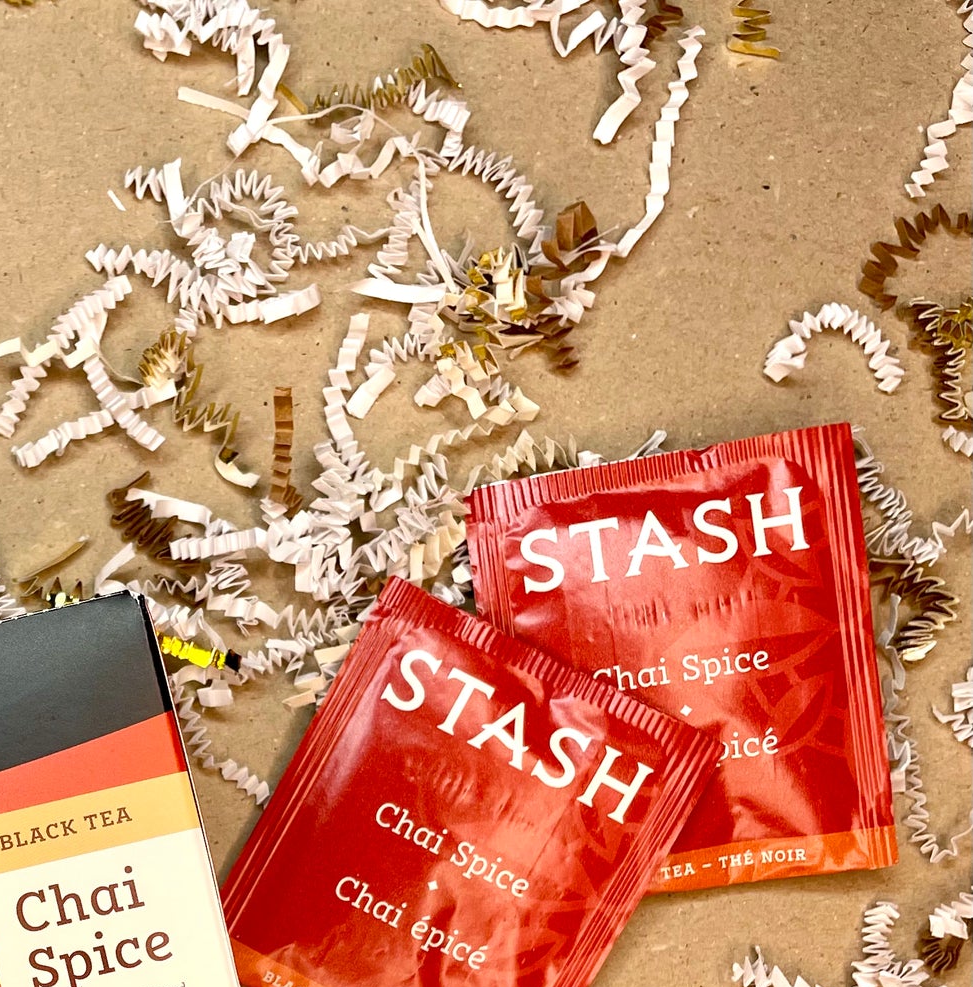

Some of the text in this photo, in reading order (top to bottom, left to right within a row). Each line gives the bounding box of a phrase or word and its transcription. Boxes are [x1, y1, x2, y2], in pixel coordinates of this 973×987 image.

[519, 485, 811, 595] STASH
[682, 648, 769, 685] Spice
[380, 649, 654, 825] STASH
[83, 807, 133, 832] TEA
[376, 803, 529, 898] Chai Spice
[15, 865, 145, 931] Chai
[660, 863, 696, 880] TEA
[718, 850, 754, 869] THÉ
[761, 848, 807, 864] NOIR
[335, 876, 489, 970] Chai épicé
